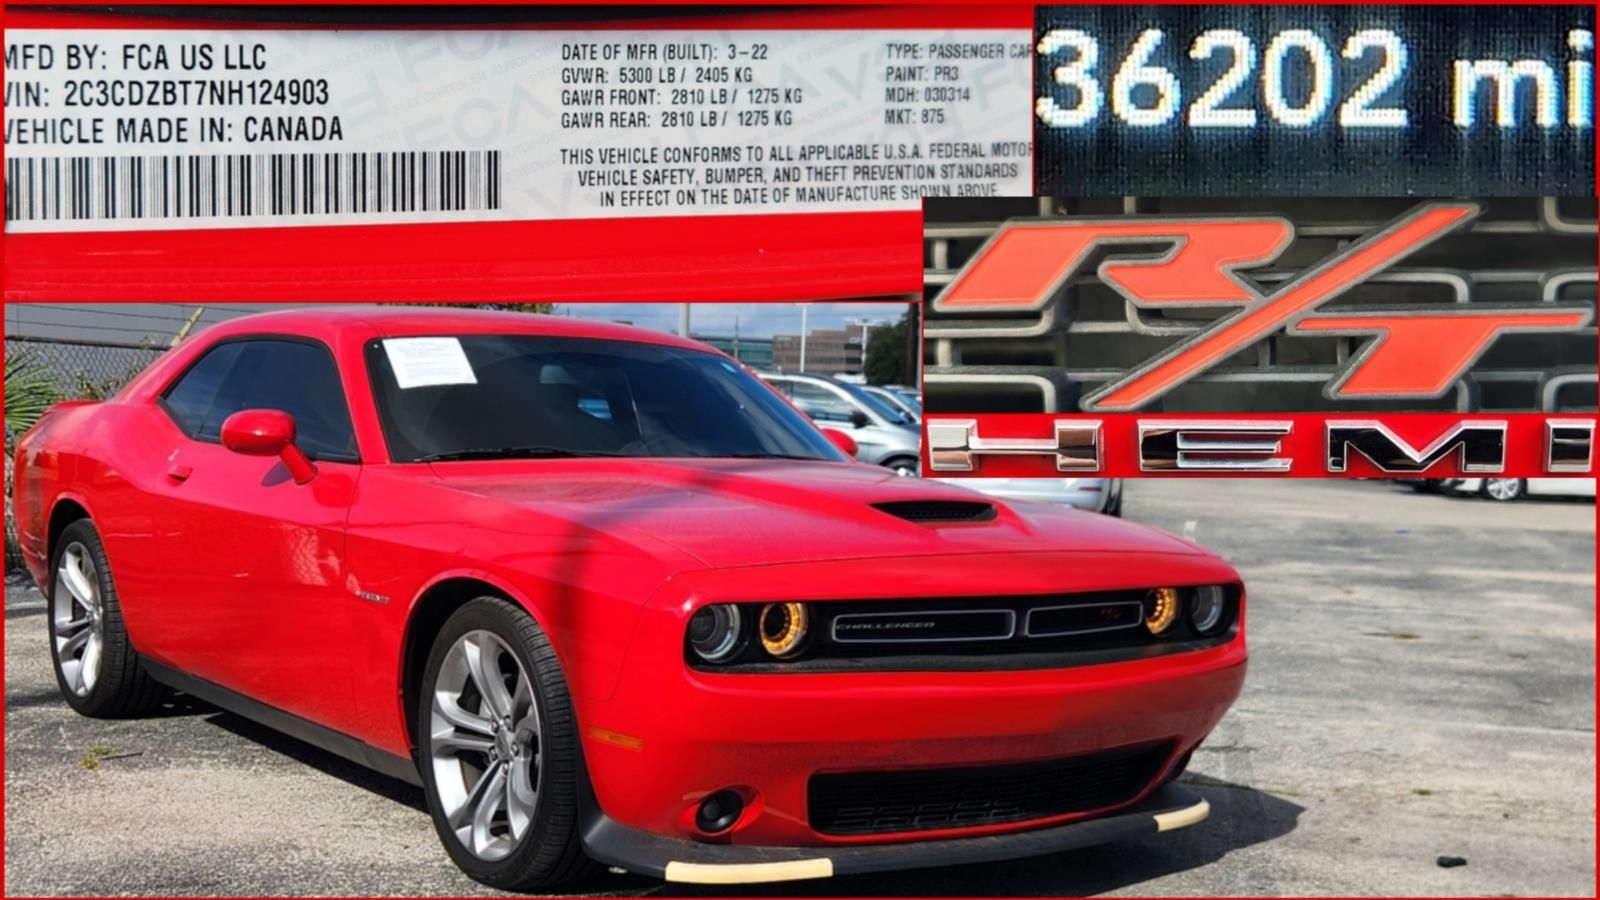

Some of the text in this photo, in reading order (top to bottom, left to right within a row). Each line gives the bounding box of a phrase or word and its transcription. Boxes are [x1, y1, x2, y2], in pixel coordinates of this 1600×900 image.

[4, 44, 266, 70] MFD BY: FCA US LLC
[562, 44, 768, 62] DATE OF MFR (BUILT): 3-22
[886, 43, 922, 59] TYPE:
[929, 44, 1004, 59] PASSENGER
[562, 67, 608, 83] GVWR:
[620, 67, 652, 83] 5300
[696, 67, 728, 83] 2405
[735, 67, 752, 82] KG
[886, 66, 958, 81] PAINT: PR3
[1036, 28, 1595, 129] 36202 mi
[65, 79, 328, 106] 2C3CDZBT7NH124903
[562, 89, 604, 105] GAWR
[610, 89, 660, 105] FRONT:
[672, 89, 704, 105] 2810
[748, 88, 779, 104] 1275
[785, 88, 802, 103] KG
[886, 87, 970, 102] MDH: 030314
[562, 112, 604, 128] GAWR
[610, 112, 650, 128] REAR:
[662, 111, 694, 127] 2810
[738, 110, 769, 126] 1275
[775, 110, 792, 125] KG
[885, 108, 944, 124] MKT: 875
[117, 118, 187, 143] MADE
[201, 118, 232, 142] IN:
[245, 116, 343, 142] CANADA
[560, 149, 593, 164] THIS
[599, 147, 657, 164] VEHICLE
[664, 147, 741, 163] CONFORMS
[746, 147, 763, 162] TO
[770, 146, 793, 161] ALL
[799, 145, 878, 160] APPLICABLE
[884, 144, 923, 159] U.S.A.
[930, 143, 986, 158] FEDERAL
[578, 163, 1018, 186] VEHICLE SAFETY, BUMPER, AND THEFT PREVENTION STANDARDS
[601, 192, 614, 206] IN
[621, 190, 670, 206] EFFECT
[677, 190, 695, 205] ON
[701, 189, 728, 204] THE
[734, 188, 767, 204] DATE
[773, 187, 790, 203] OF
[796, 185, 896, 202] MANUFACTURE
[901, 184, 952, 197] SHOWN
[932, 202, 1595, 411] R/T
[927, 418, 1596, 472] HEMI
